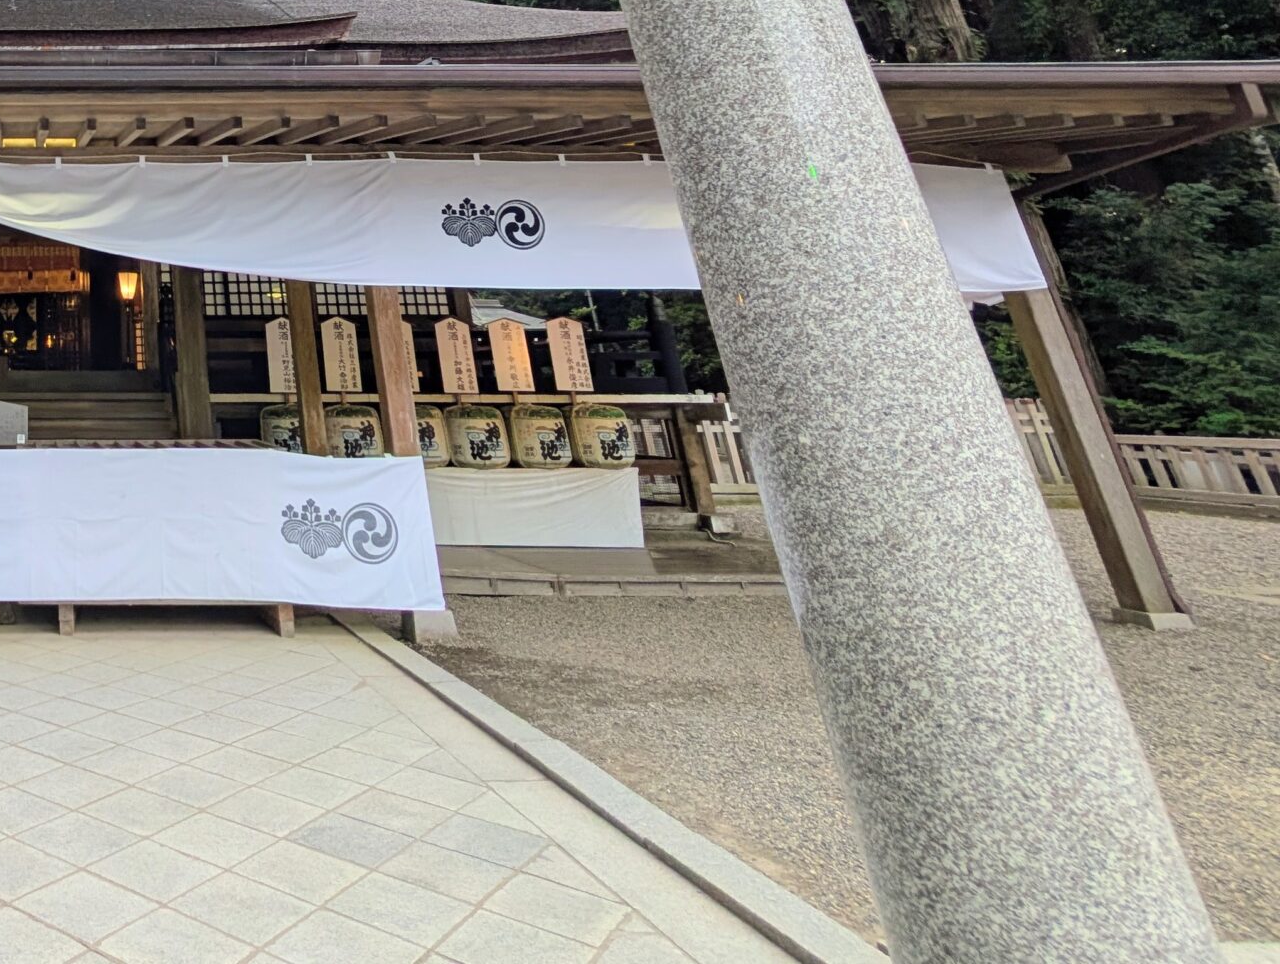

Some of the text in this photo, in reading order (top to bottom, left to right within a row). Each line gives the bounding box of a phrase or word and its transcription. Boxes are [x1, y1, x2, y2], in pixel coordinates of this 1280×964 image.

[278, 320, 289, 340] 献酒
[332, 320, 344, 340] 献酒
[447, 320, 458, 340] 献酒
[559, 320, 571, 340] 献酒
[469, 420, 501, 460] 神の池
[539, 420, 568, 460] 神の池
[599, 420, 629, 460] 神の池
